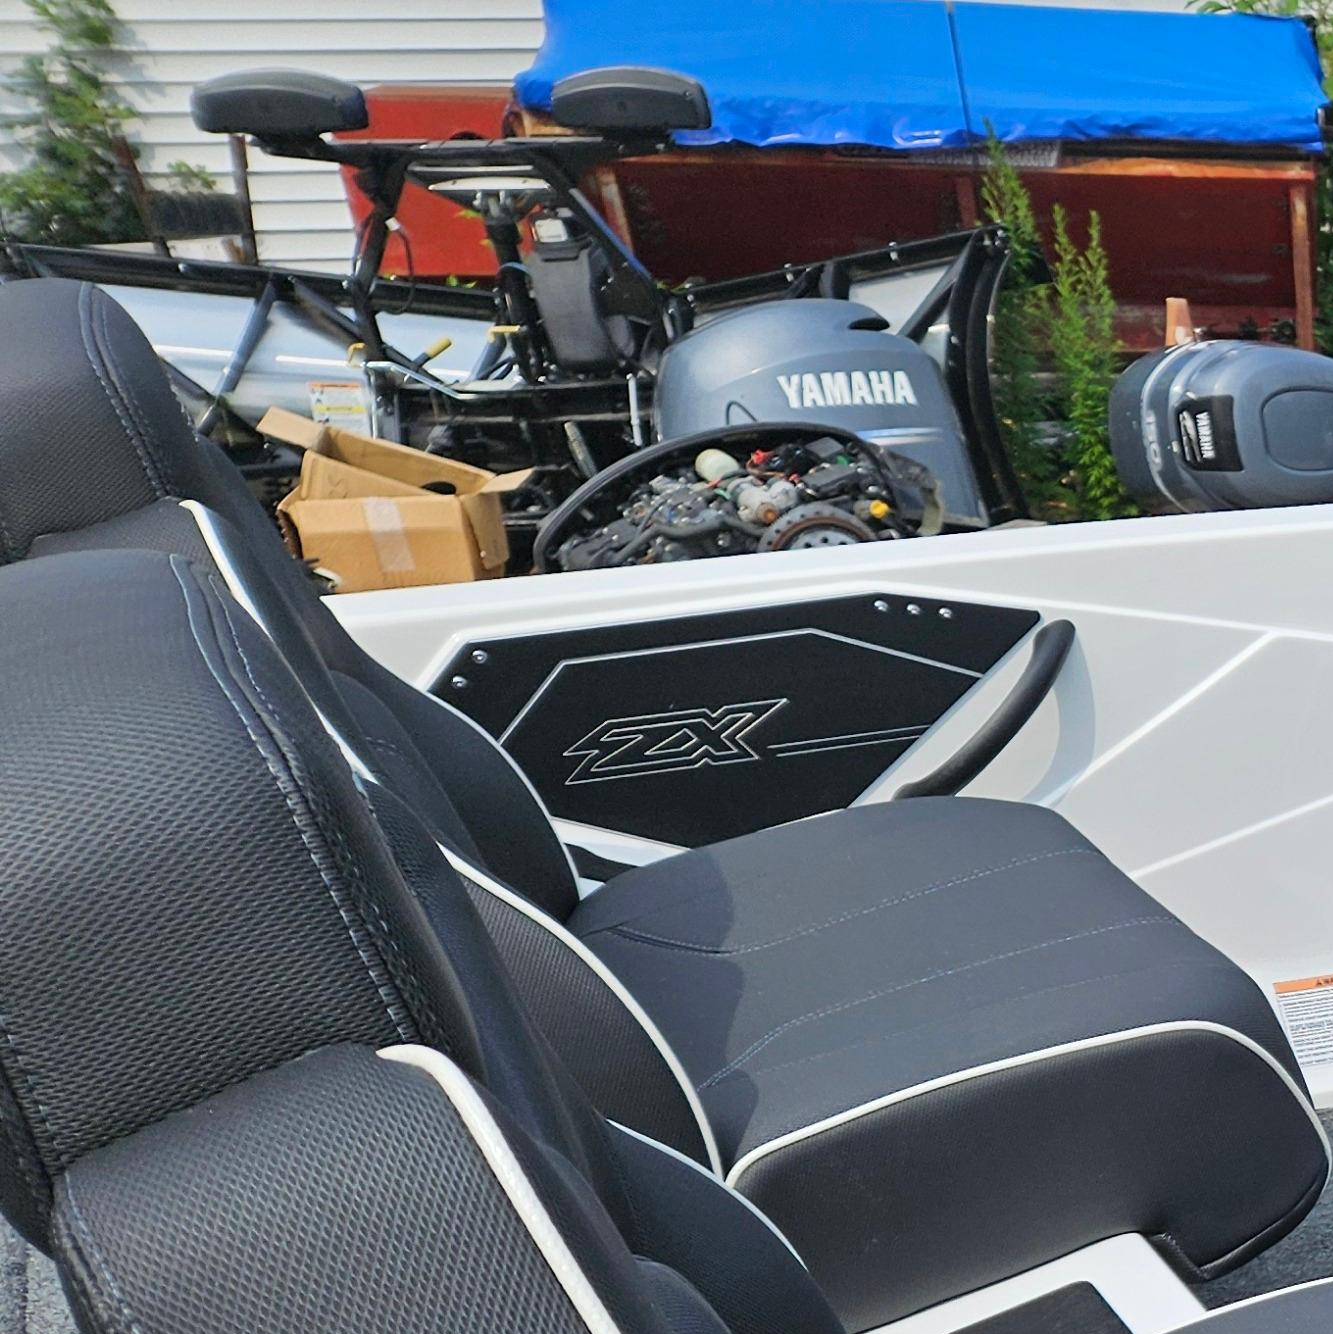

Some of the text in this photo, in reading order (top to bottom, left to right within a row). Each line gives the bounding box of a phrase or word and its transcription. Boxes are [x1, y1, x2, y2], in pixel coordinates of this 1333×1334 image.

[776, 370, 919, 409] YAMAHA
[1196, 411, 1215, 459] YAMAHA
[563, 698, 789, 785] ZX
